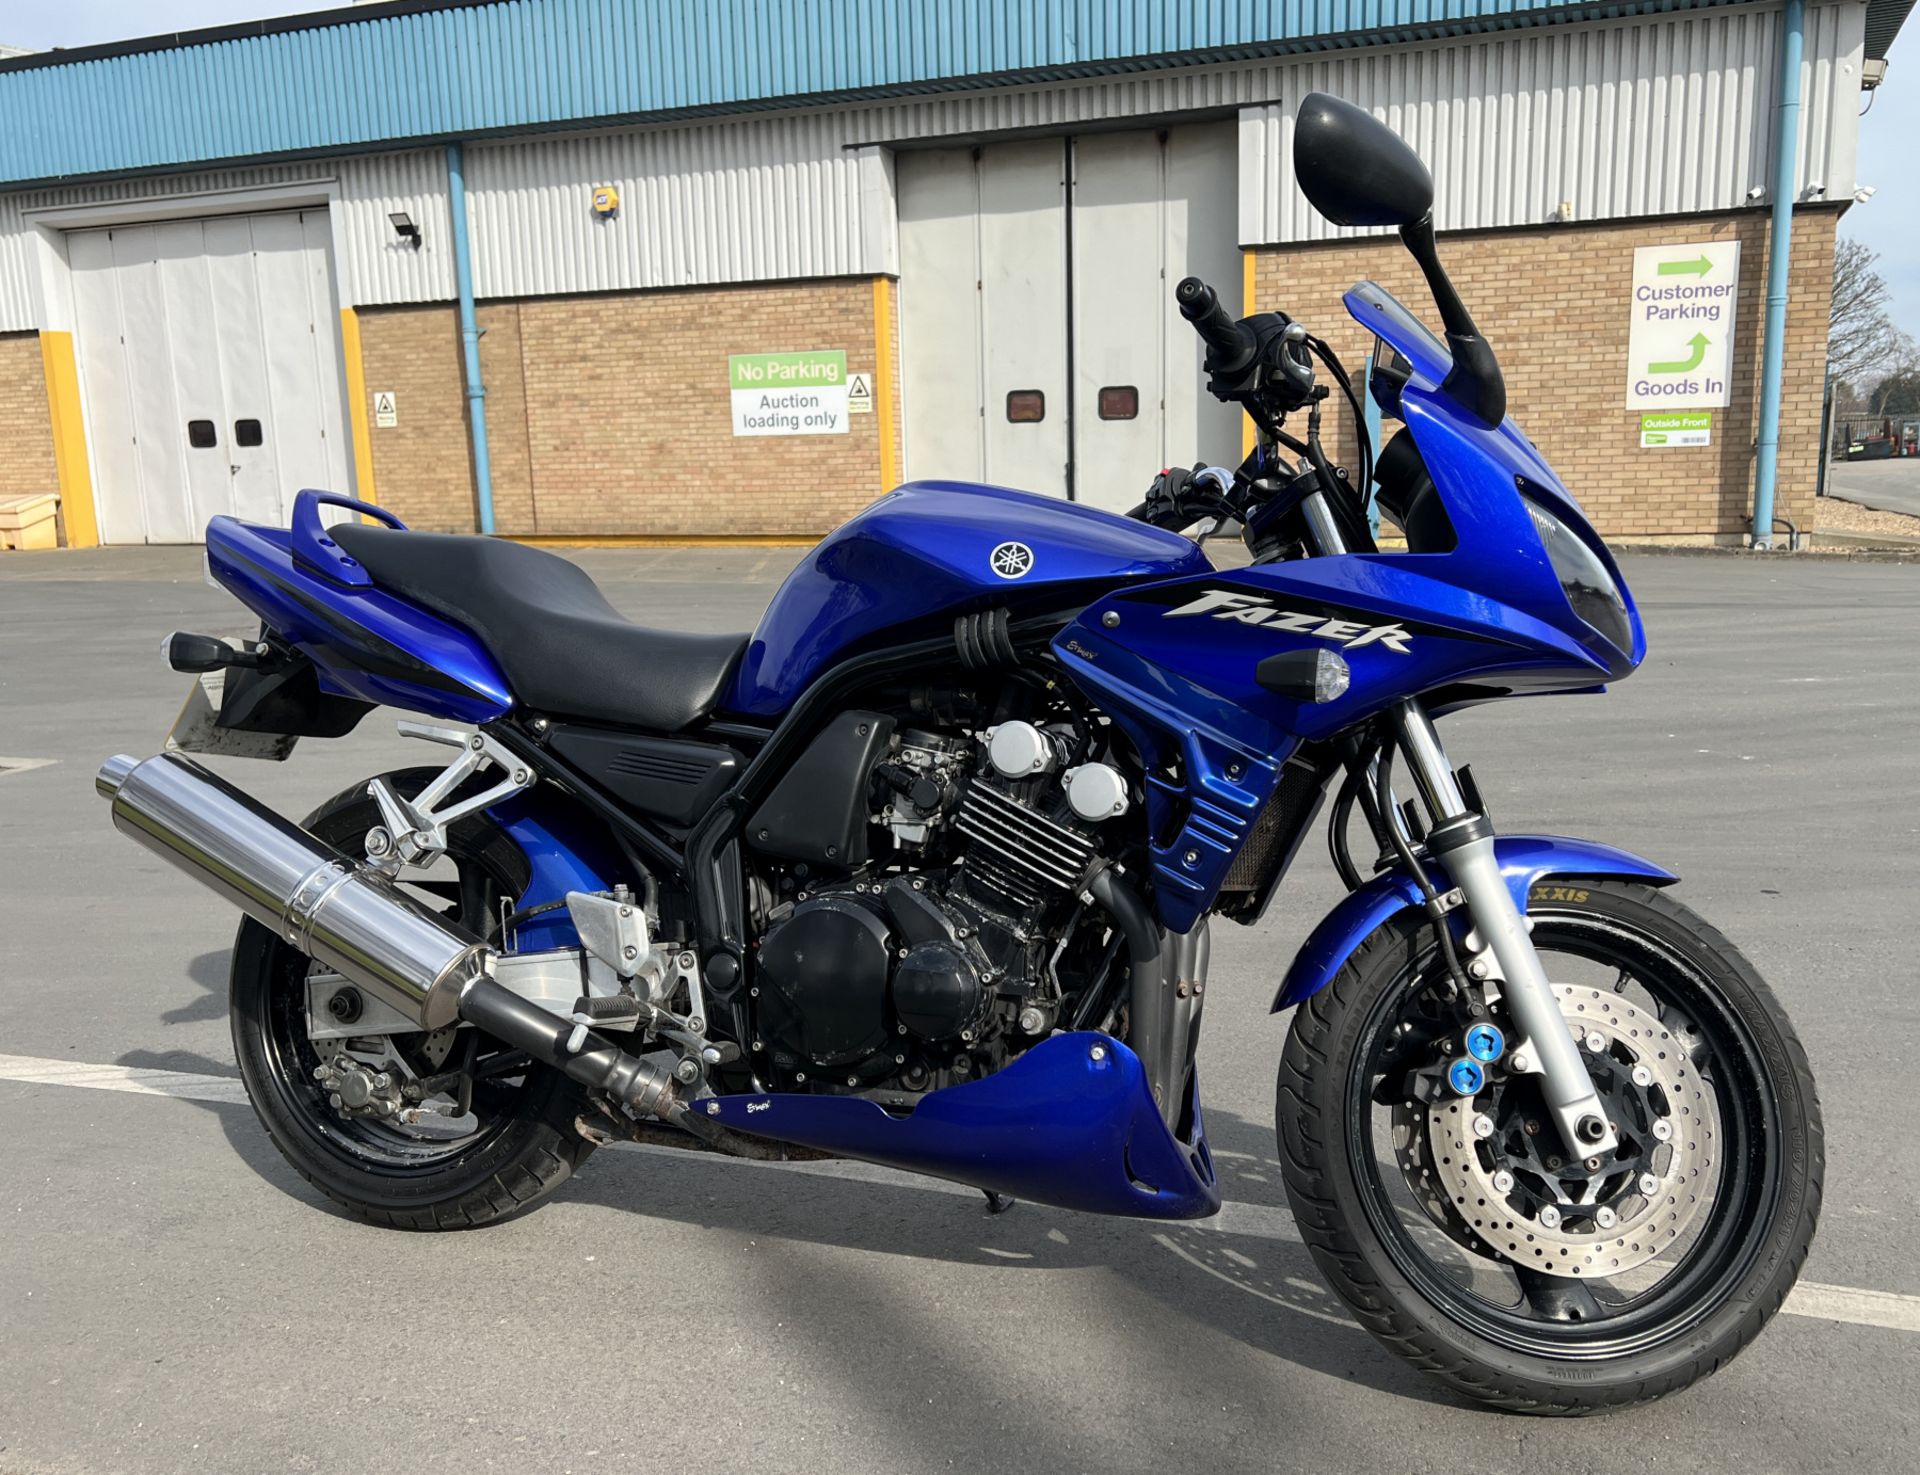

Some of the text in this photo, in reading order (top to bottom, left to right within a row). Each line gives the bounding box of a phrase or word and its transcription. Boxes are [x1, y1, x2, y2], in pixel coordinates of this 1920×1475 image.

[1636, 283, 1734, 301] Customer
[1646, 302, 1720, 321] Parking
[737, 360, 838, 382] No Parking
[1635, 378, 1723, 397] Goods In
[760, 393, 819, 410] Auction
[743, 411, 837, 430] loading only
[1645, 418, 1708, 428] Outside Front
[1161, 589, 1413, 654] FAZER
[1529, 887, 1589, 903] XXIS
